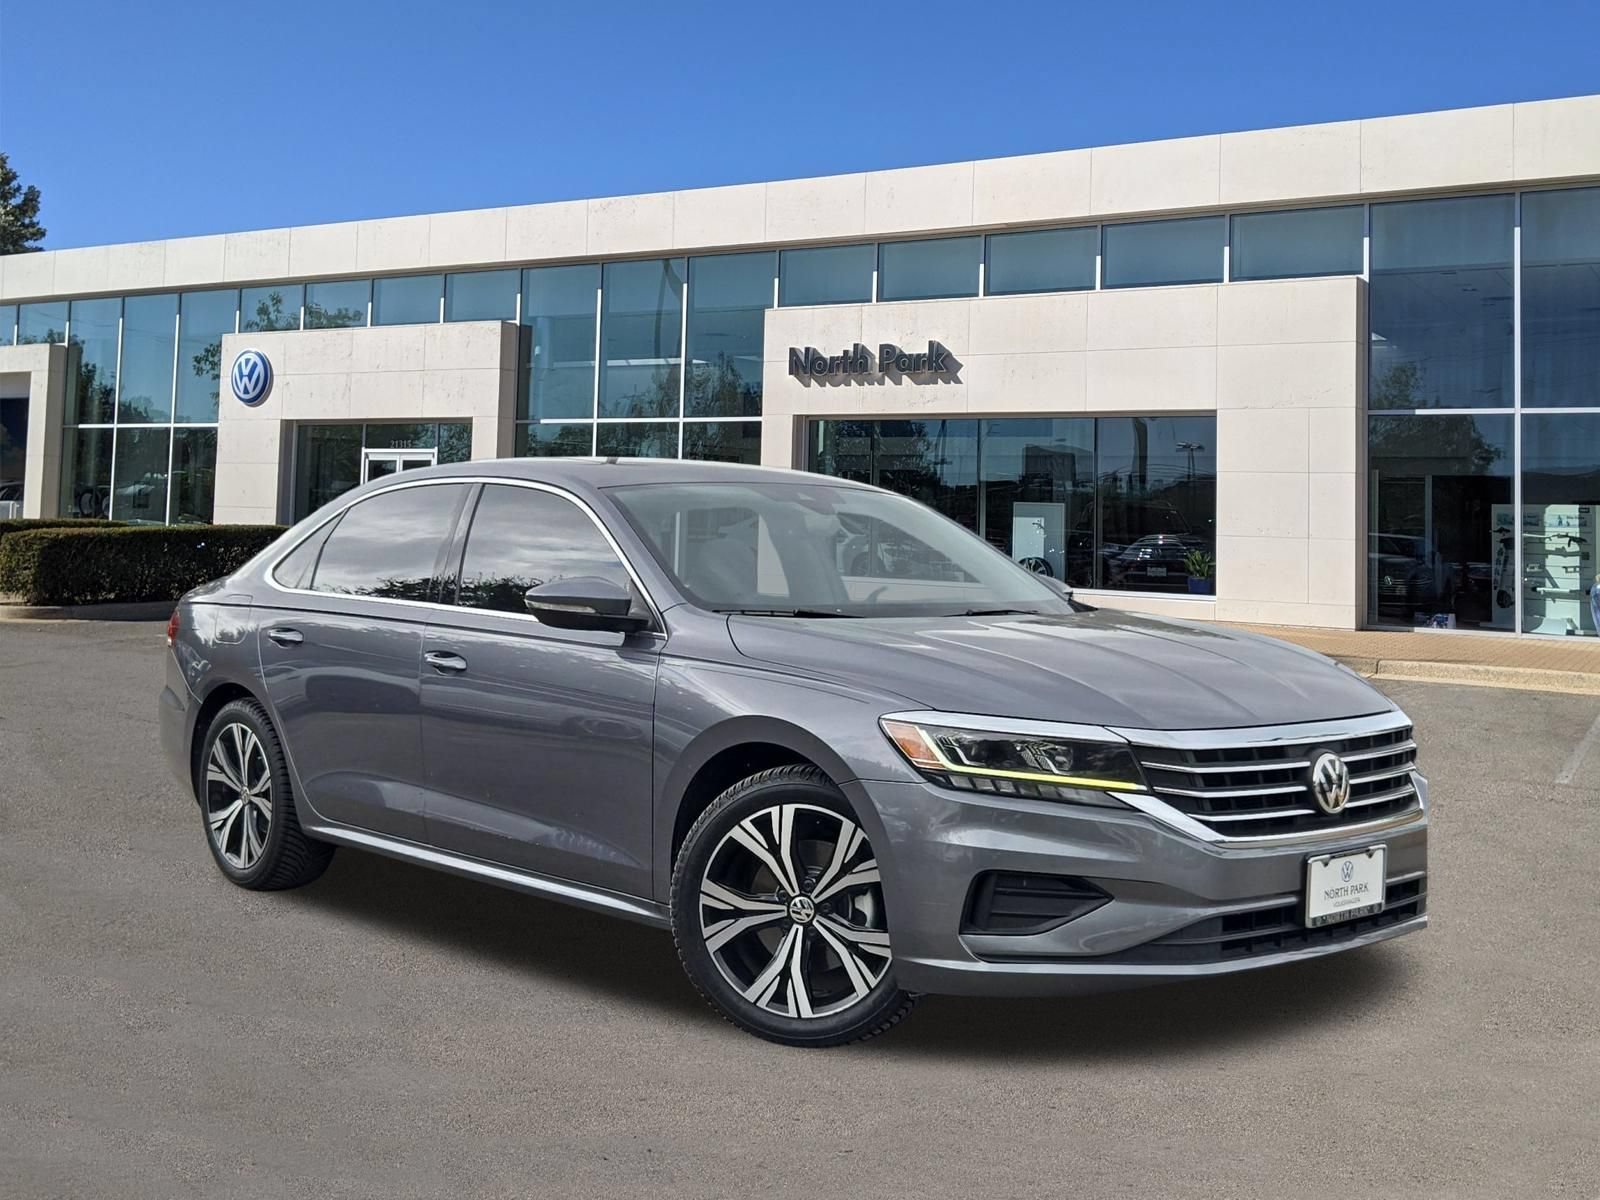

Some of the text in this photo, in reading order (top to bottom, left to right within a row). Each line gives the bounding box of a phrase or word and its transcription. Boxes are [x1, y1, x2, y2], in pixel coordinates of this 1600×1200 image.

[788, 340, 947, 376] North Park
[232, 351, 267, 403] VW
[1324, 882, 1369, 899] NORTH PARK
